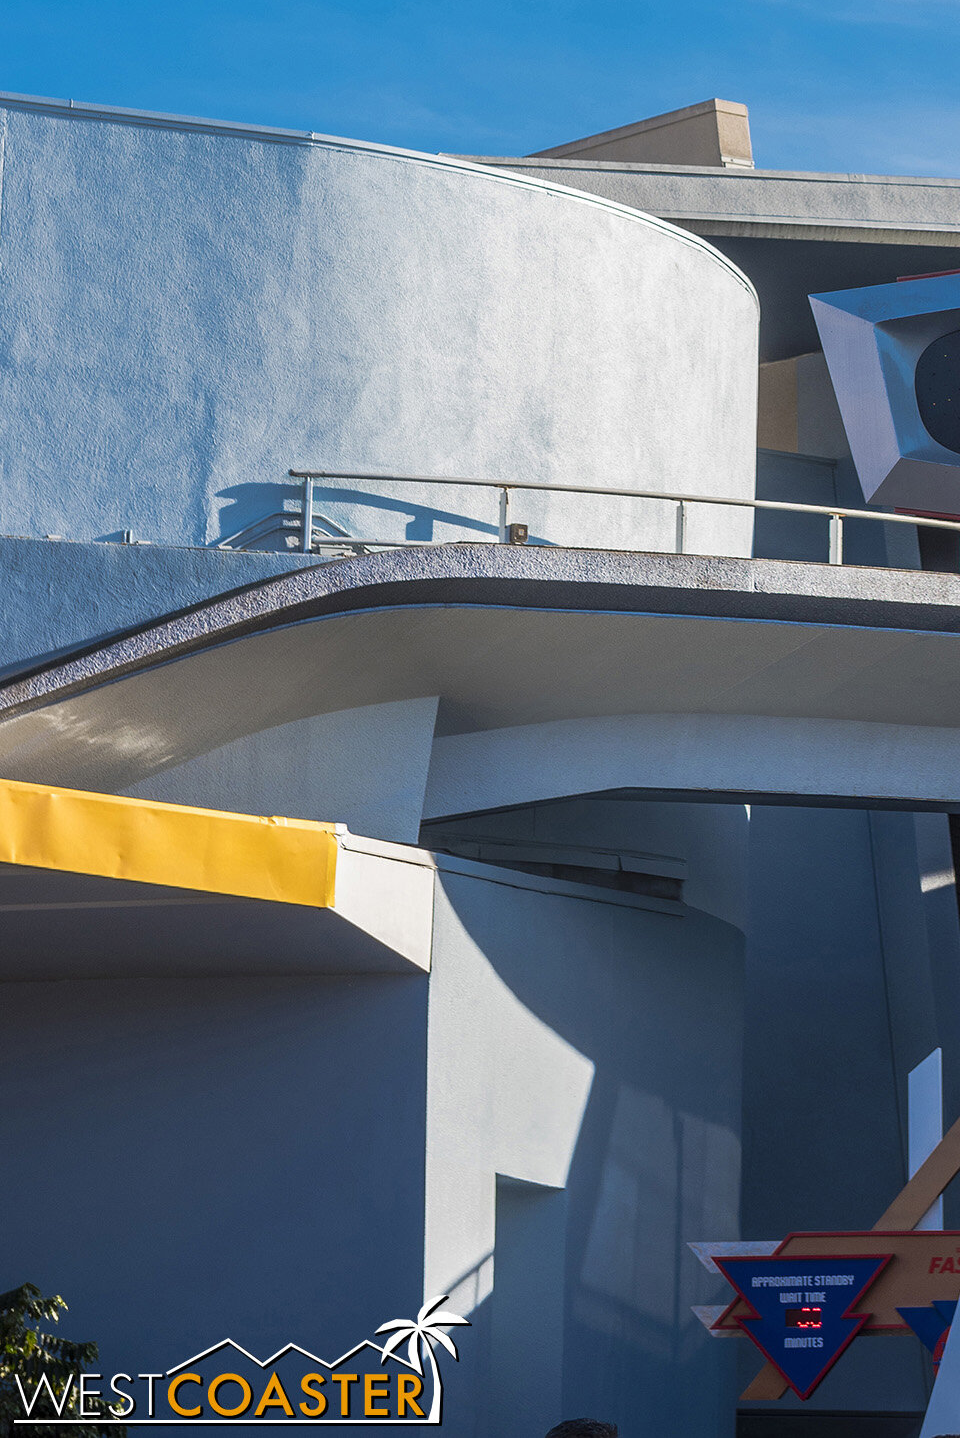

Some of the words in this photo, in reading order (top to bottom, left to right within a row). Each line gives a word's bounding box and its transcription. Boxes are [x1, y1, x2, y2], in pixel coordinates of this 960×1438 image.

[751, 1275, 813, 1288] APPROXIMATE
[814, 1274, 855, 1286] STANDBY
[780, 1292, 803, 1303] WAIT
[804, 1291, 826, 1303] TIME
[784, 1337, 824, 1349] MINUTES
